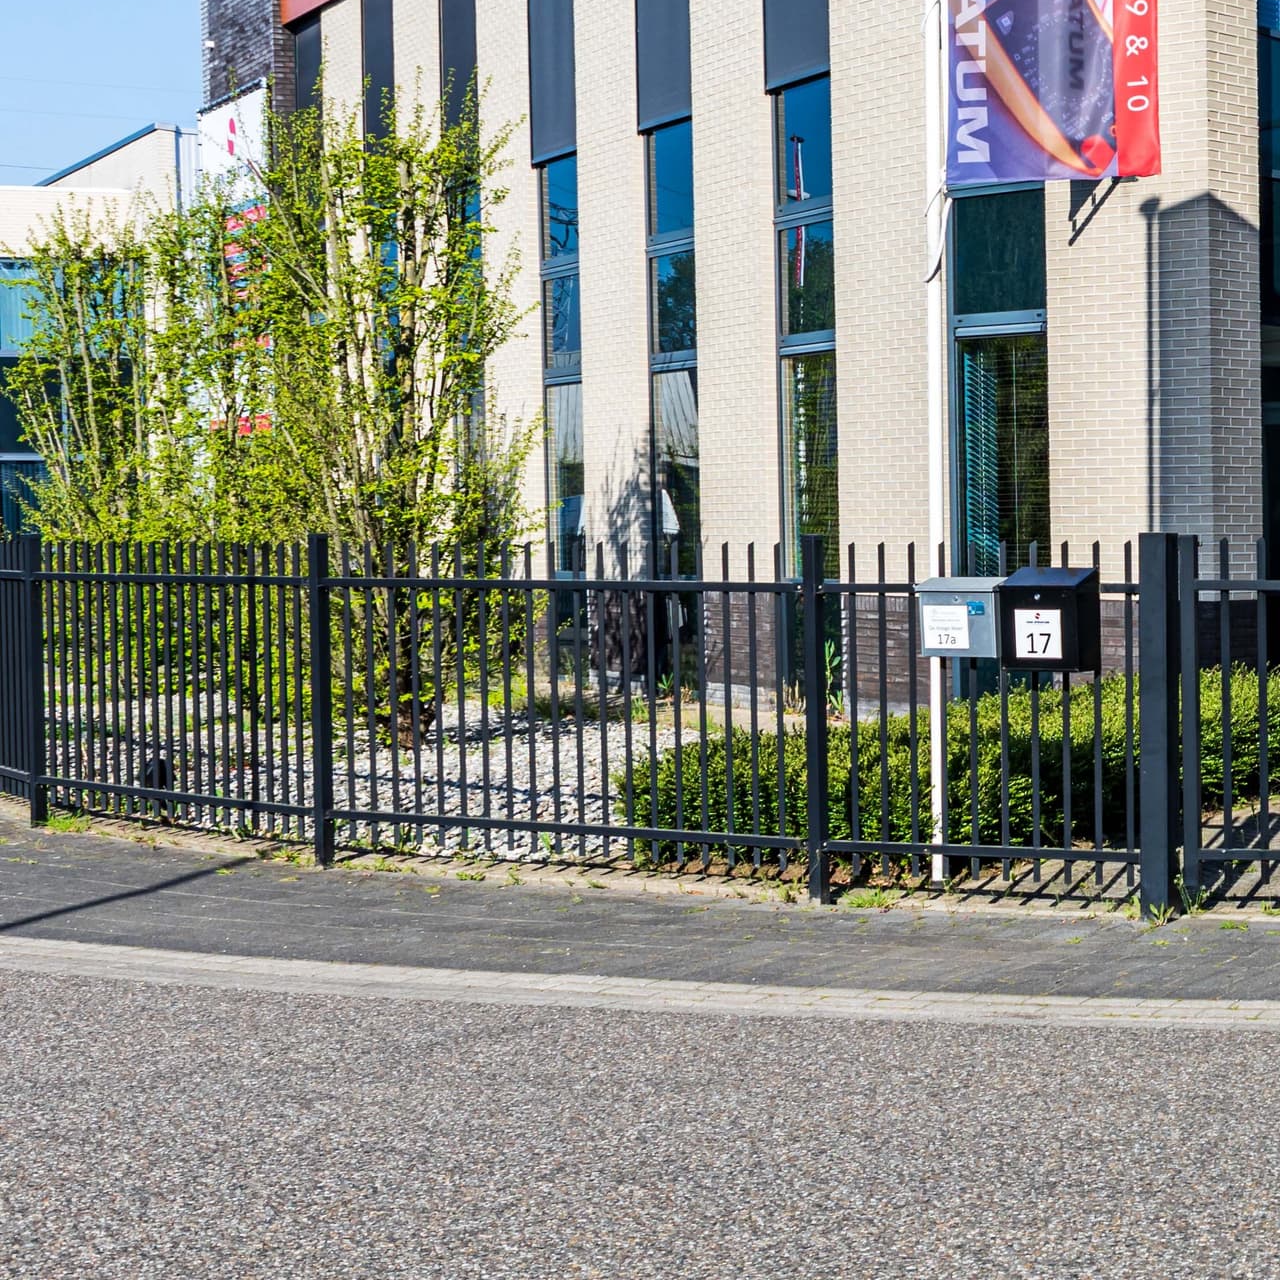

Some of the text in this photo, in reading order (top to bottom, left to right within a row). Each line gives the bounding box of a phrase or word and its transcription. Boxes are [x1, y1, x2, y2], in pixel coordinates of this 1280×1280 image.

[1123, 0, 1149, 16] 9
[1124, 33, 1149, 57] &
[1125, 74, 1150, 112] 10
[938, 633, 957, 645] 17a
[1026, 632, 1051, 654] 17
